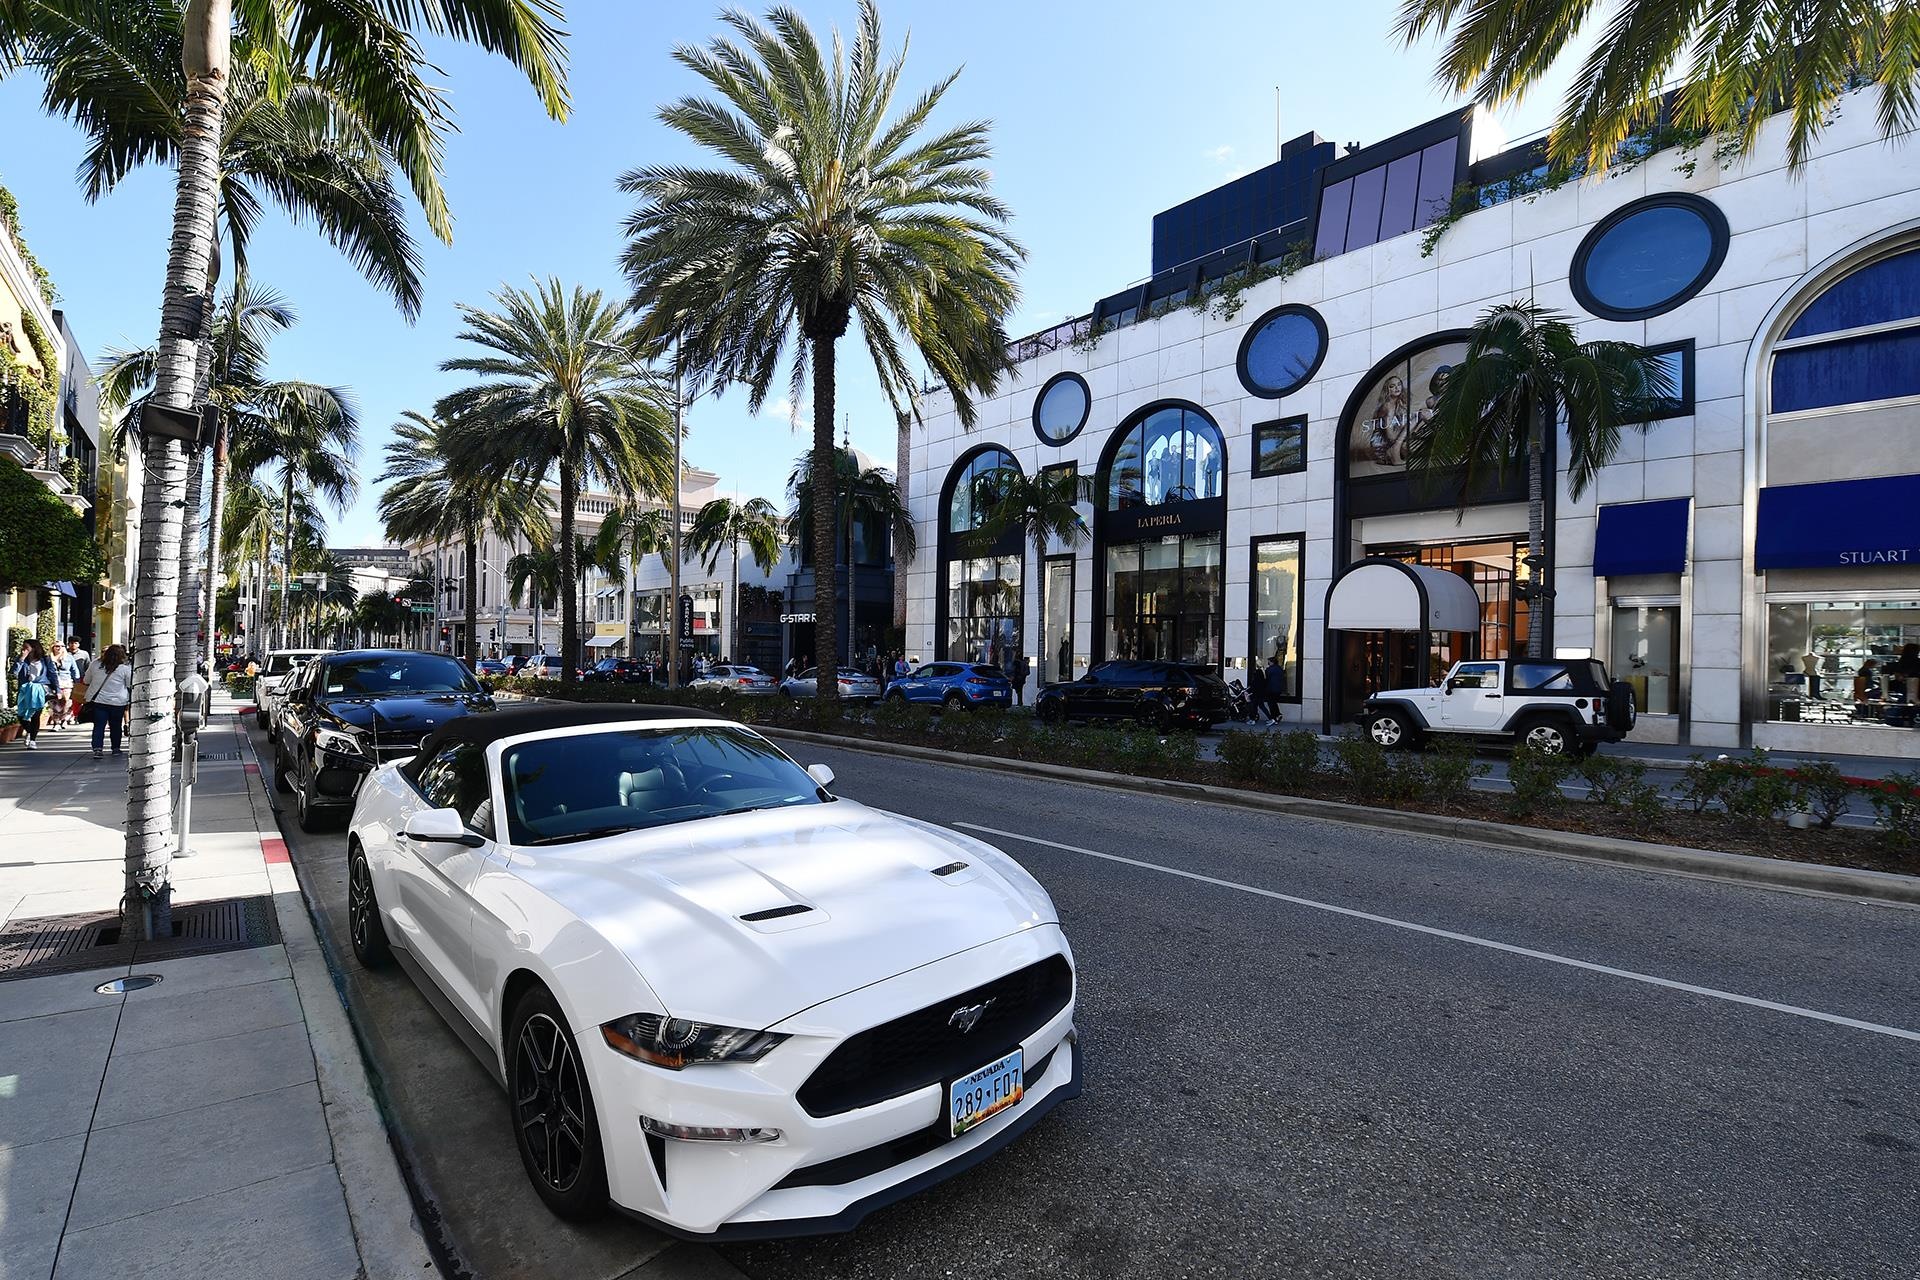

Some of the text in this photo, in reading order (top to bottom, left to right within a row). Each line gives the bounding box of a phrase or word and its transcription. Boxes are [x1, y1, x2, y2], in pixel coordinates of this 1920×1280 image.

[1839, 549, 1910, 564] STUART
[780, 613, 810, 623] G-STAR
[969, 1060, 1006, 1086] NEVADA
[955, 1087, 983, 1124] 289
